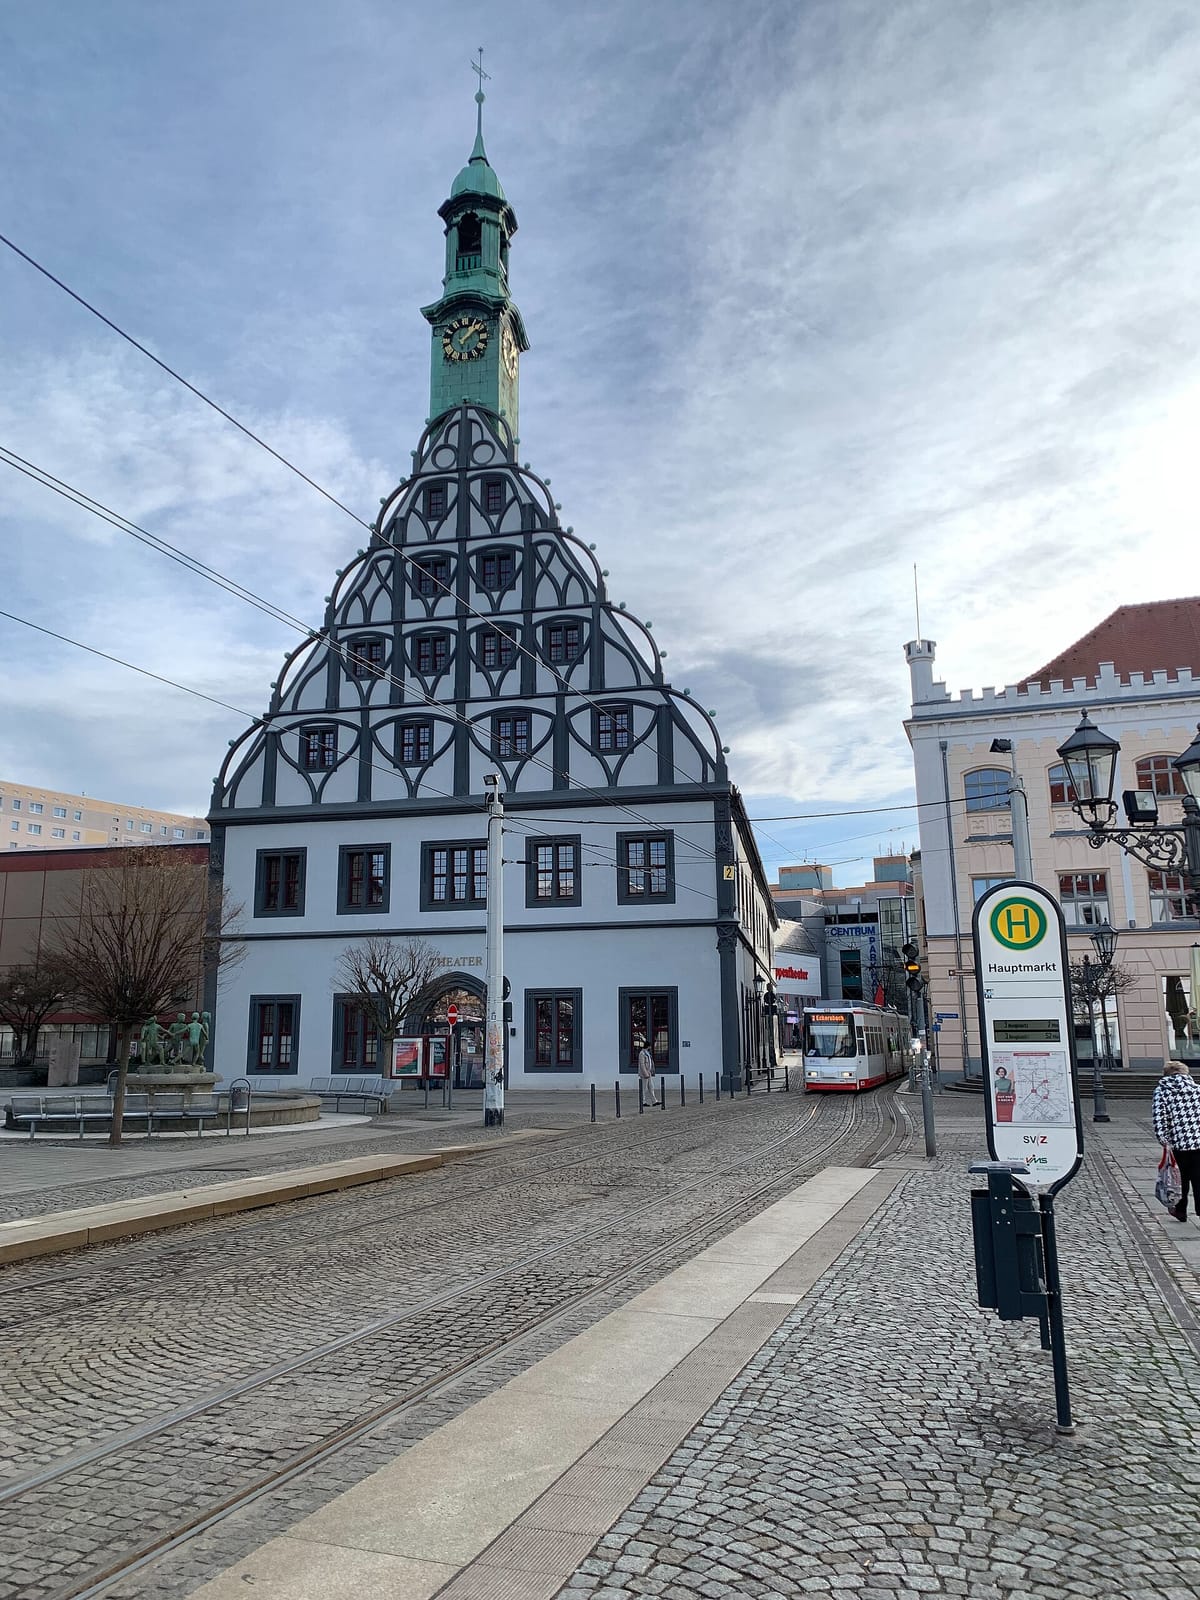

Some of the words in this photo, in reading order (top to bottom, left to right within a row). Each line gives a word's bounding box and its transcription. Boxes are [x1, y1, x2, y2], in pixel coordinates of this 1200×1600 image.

[726, 867, 732, 878] 2
[1006, 908, 1031, 939] H
[830, 926, 876, 937] CENTRUM
[429, 956, 483, 967] THEATER
[988, 962, 1057, 975] Hauptmarkt
[1025, 1154, 1048, 1166] VMS
